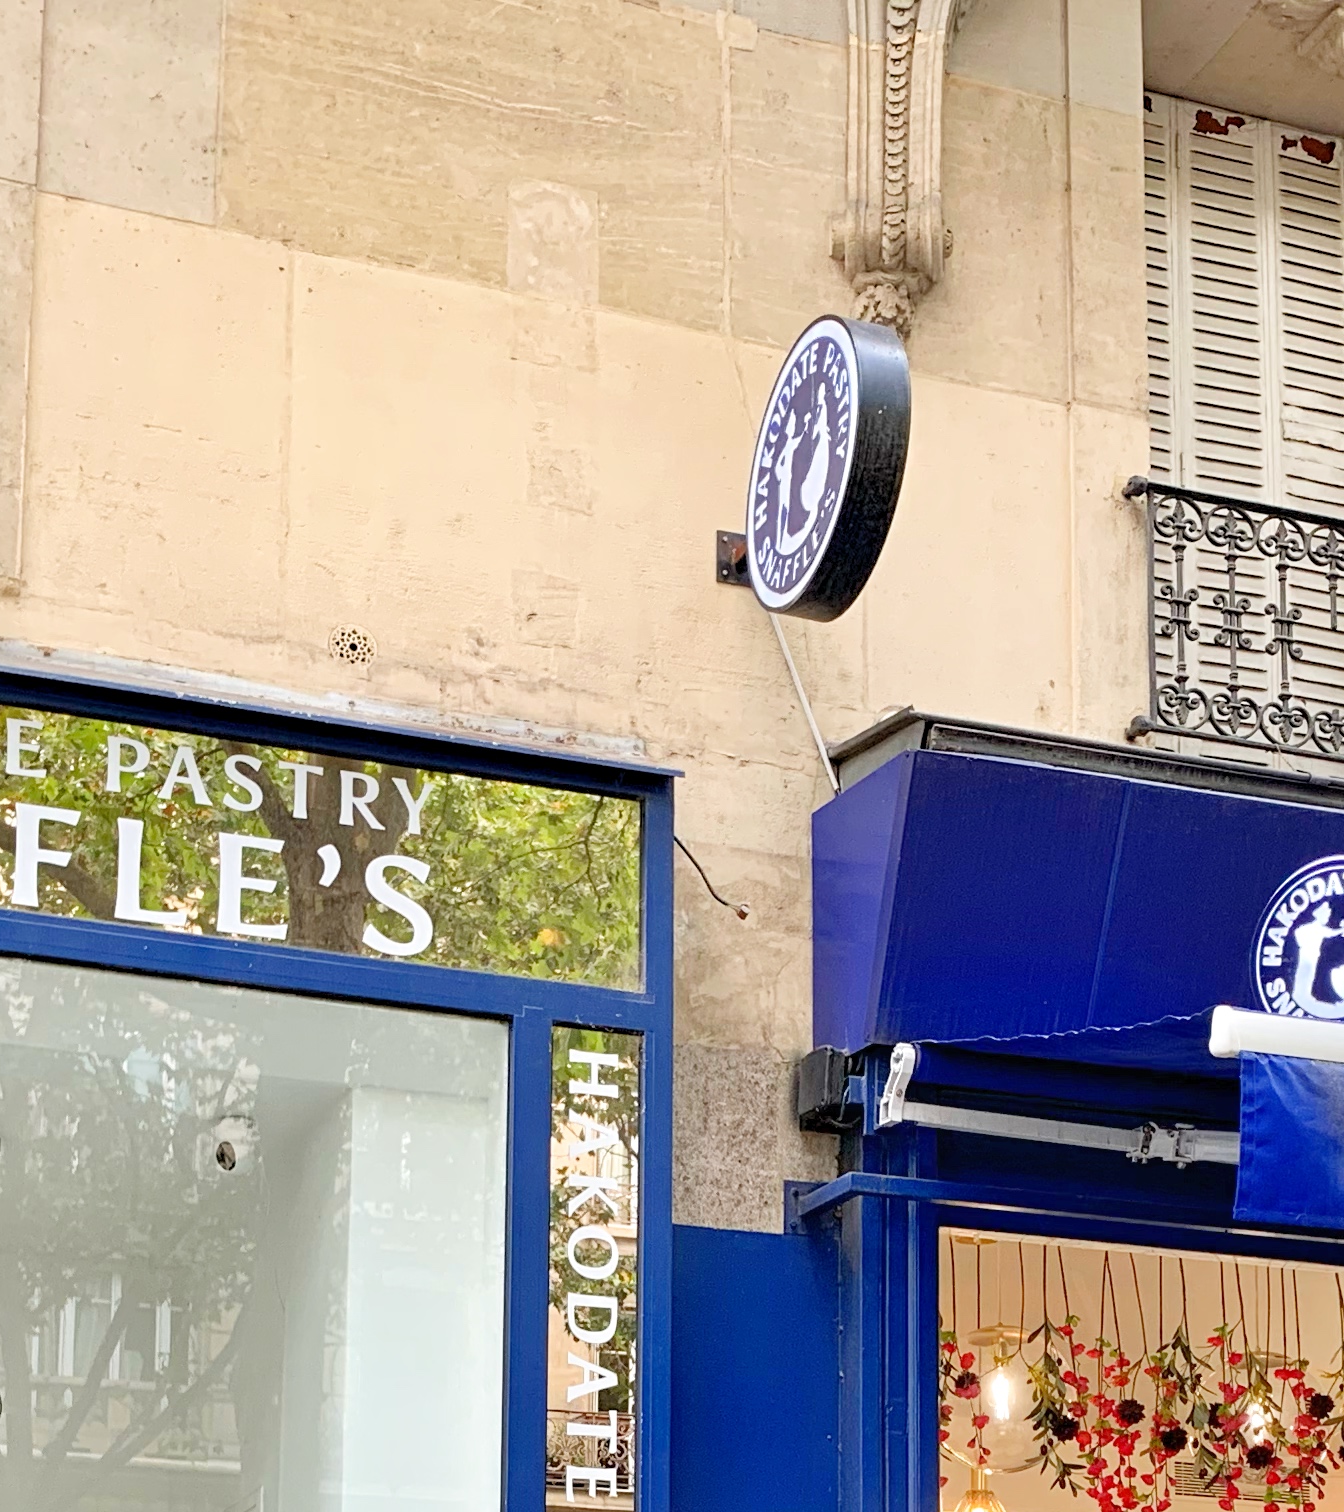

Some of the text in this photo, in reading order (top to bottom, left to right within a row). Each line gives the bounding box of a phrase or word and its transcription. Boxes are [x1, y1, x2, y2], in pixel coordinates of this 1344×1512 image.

[756, 343, 819, 531] HAKODATE
[106, 735, 436, 838] PASTRY
[563, 1050, 621, 1503] HAKODATE
